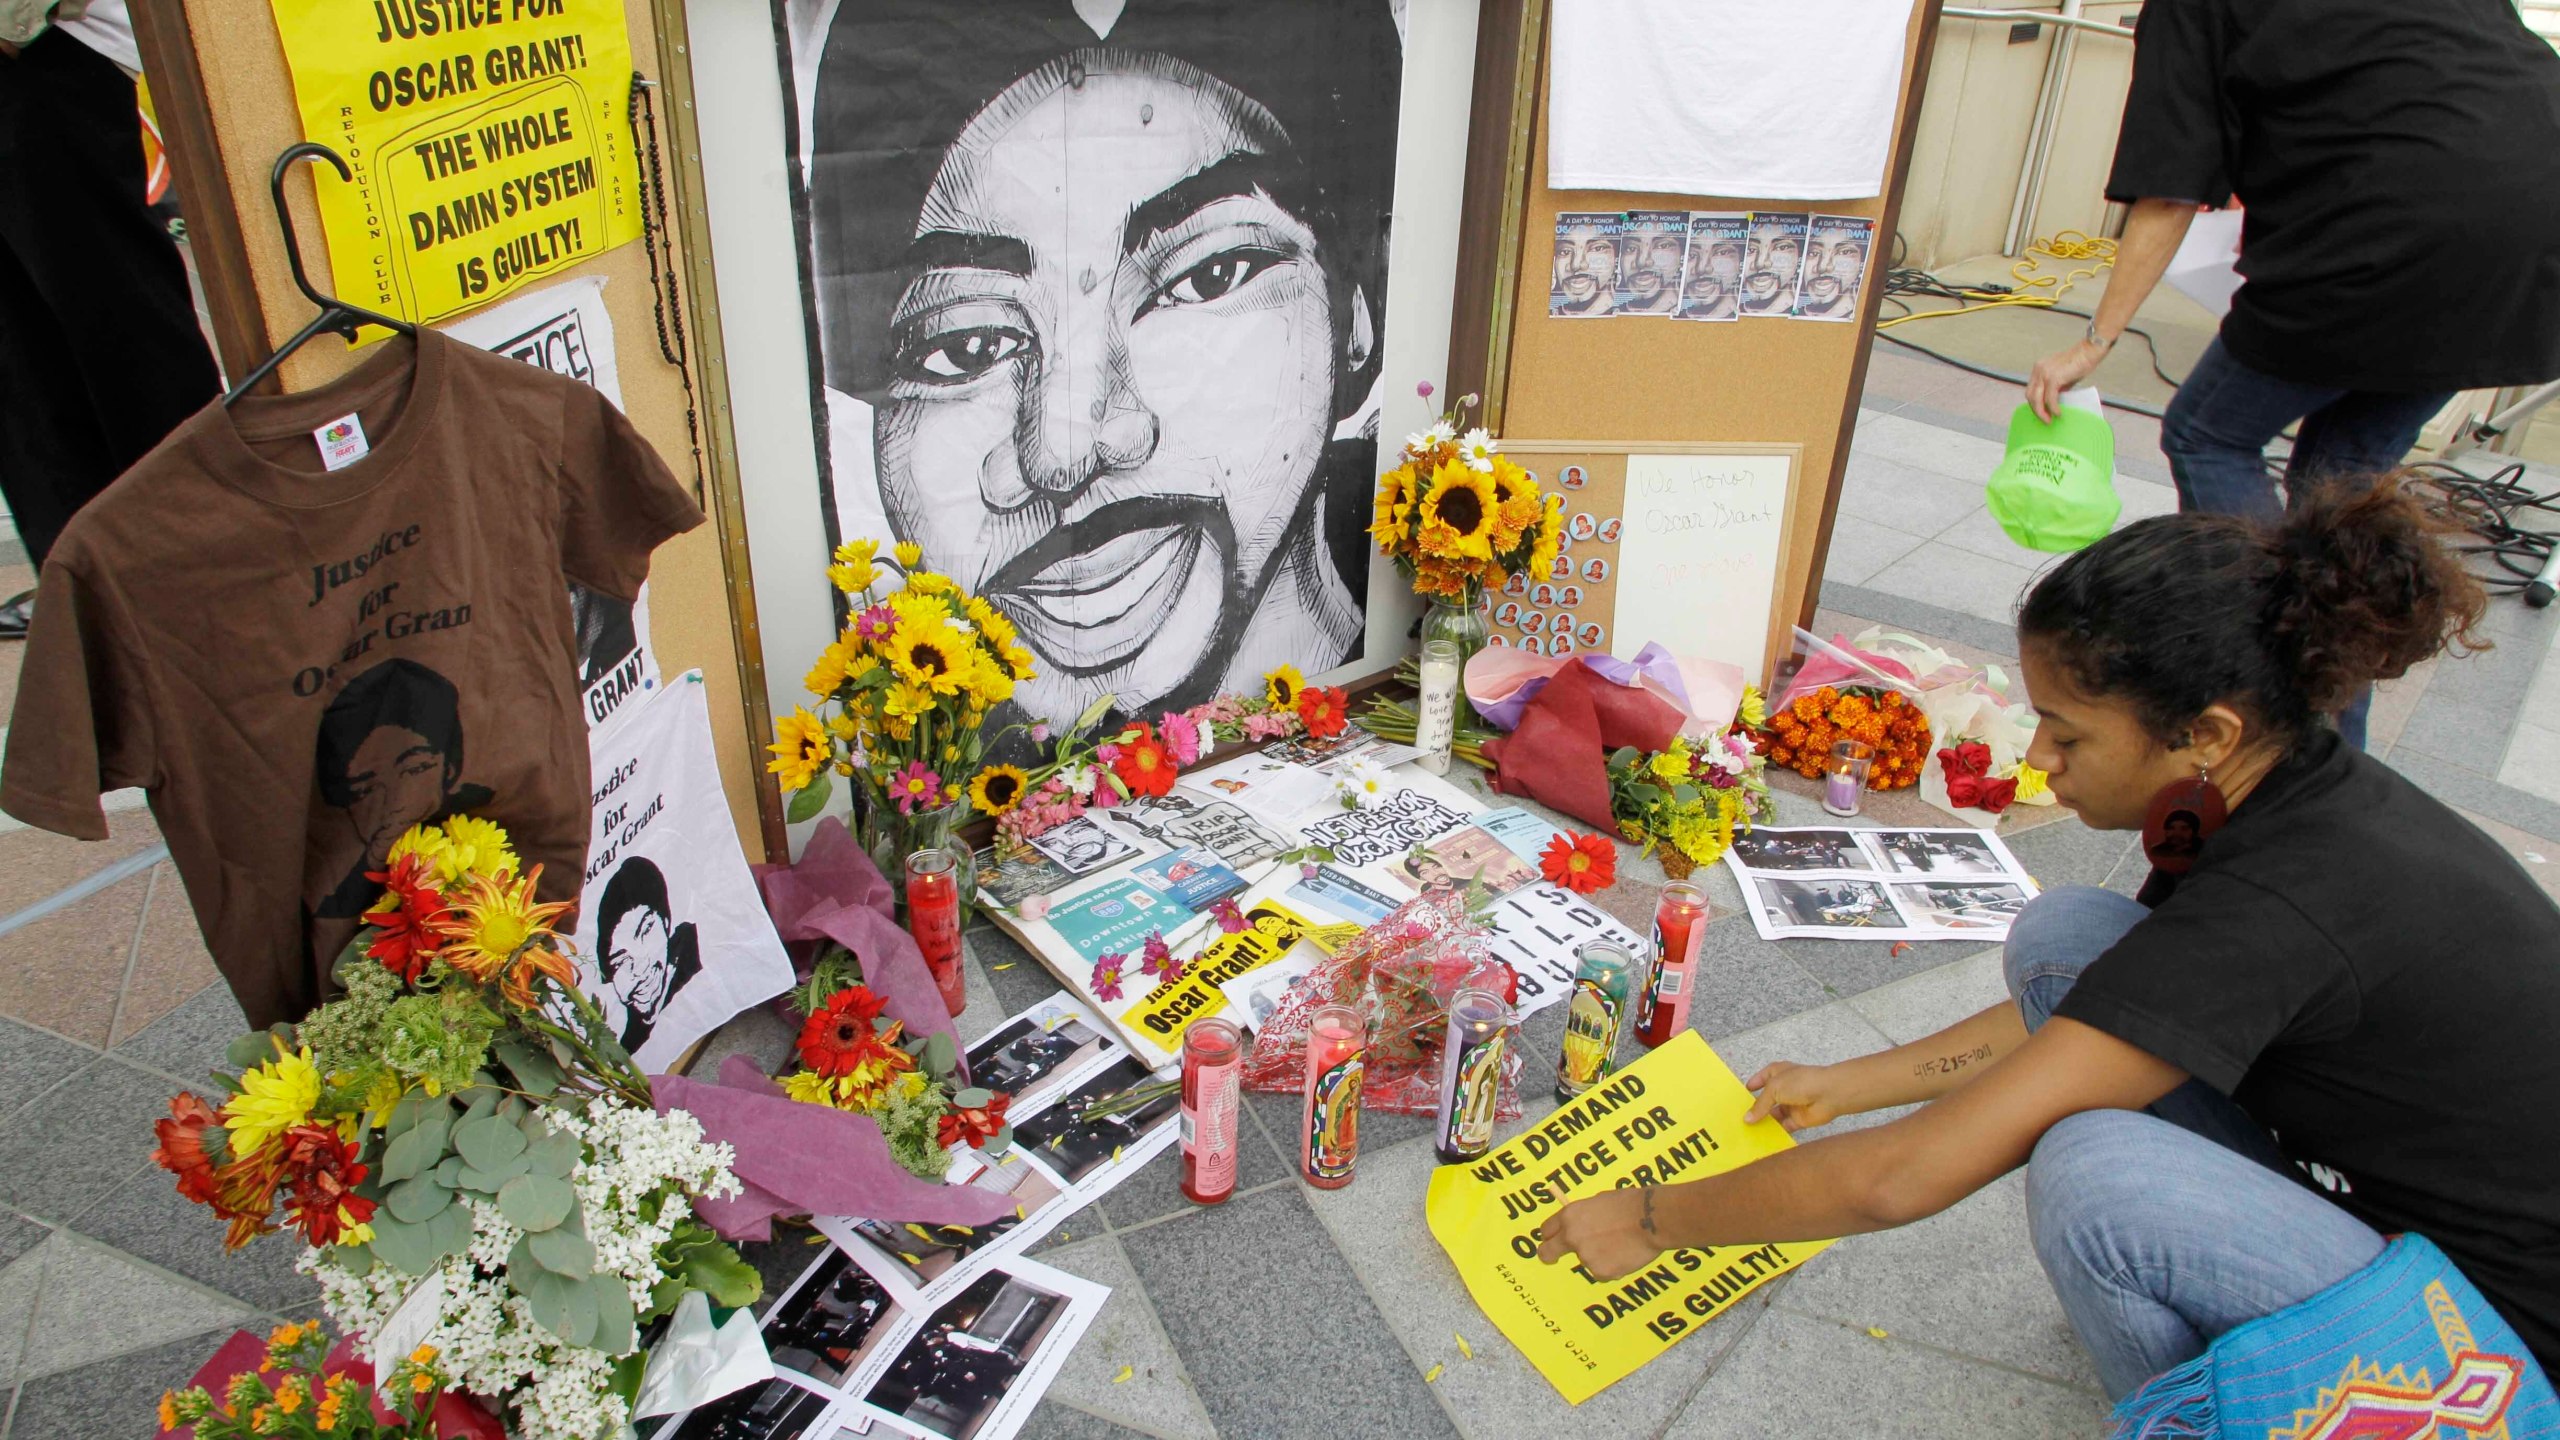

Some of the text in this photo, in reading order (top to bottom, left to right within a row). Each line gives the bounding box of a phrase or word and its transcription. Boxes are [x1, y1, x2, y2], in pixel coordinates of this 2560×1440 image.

[374, 0, 502, 43] JUSTICE
[368, 34, 588, 112] OSCAR GRANT!
[415, 107, 573, 182] THE WHOLE
[602, 100, 624, 217] SF BAY AREA
[340, 106, 391, 304] REVOLUTION CLUB
[409, 156, 597, 252] DAMN SYSTEM
[456, 217, 583, 299] IS GUILTY!
[1640, 466, 1677, 496] We
[1645, 501, 1773, 535] Oscar Grant
[309, 523, 421, 608] Justice
[358, 581, 400, 625] for
[384, 603, 472, 641] Gran
[589, 647, 645, 724] GRANT
[592, 756, 638, 807] stice
[584, 792, 666, 886] scar Grant
[603, 800, 629, 839] for
[1192, 814, 1231, 832] RIP
[1211, 831, 1252, 850] GRANT
[1061, 898, 1093, 915] Justice
[1093, 892, 1105, 901] no
[1187, 877, 1218, 895] JUSTICE
[1320, 868, 1351, 886] DISBAND
[1364, 889, 1380, 900] BART
[1080, 910, 1153, 949] Downtown
[1103, 923, 1163, 954] Oakland
[1203, 941, 1226, 960] for
[1143, 983, 1211, 1034] Oscar
[1199, 936, 1269, 990] Grant!
[1471, 1073, 1647, 1184] WE DEMAND
[1499, 1105, 1677, 1221] JUSTICE FOR
[1495, 1263, 1561, 1336] REVOLUTION
[1564, 1340, 1598, 1371] CLUB
[1583, 1264, 1679, 1329] DAMN
[1646, 1310, 1688, 1342] IS
[1684, 1243, 1790, 1317] GUILTY!
